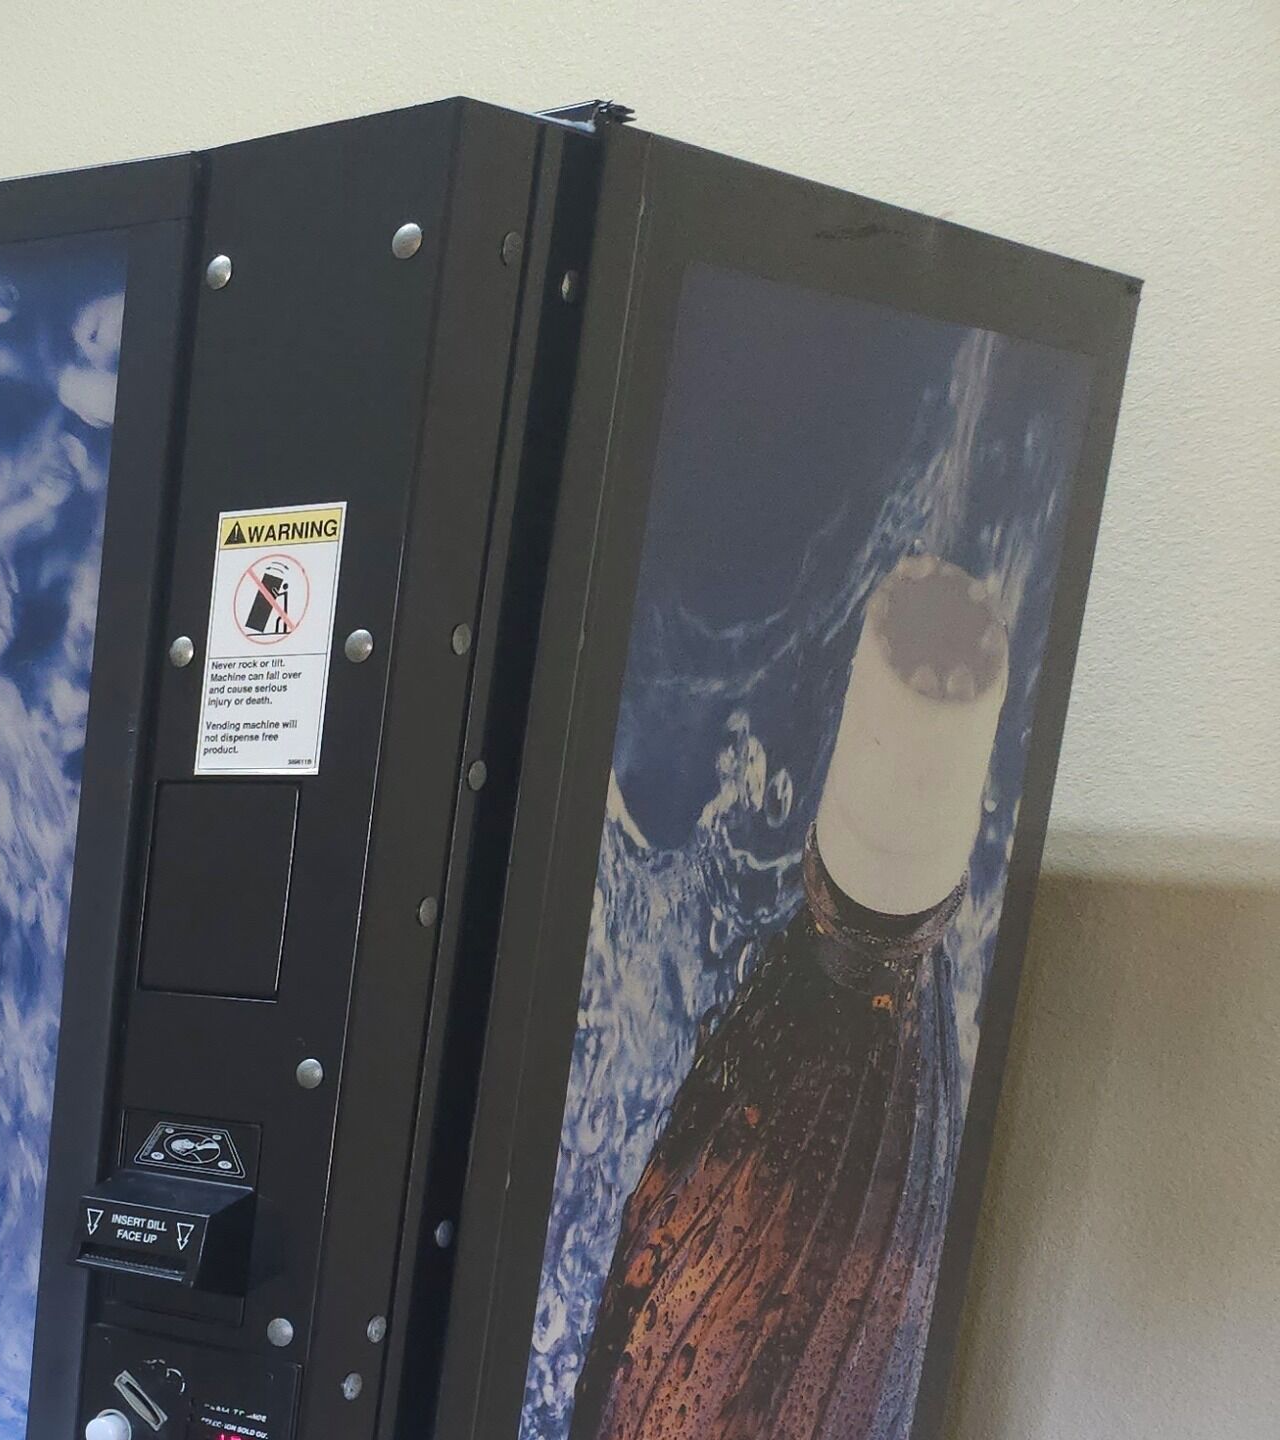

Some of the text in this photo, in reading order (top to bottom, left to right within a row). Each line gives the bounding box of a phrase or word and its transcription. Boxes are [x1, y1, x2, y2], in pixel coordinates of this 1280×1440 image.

[247, 519, 338, 543] WARNING
[211, 661, 236, 670] Never
[238, 660, 257, 668] rock
[272, 659, 285, 667] tilt.
[210, 673, 246, 682] Machine
[266, 672, 280, 680] fall
[209, 685, 225, 694] and
[254, 683, 288, 693] serious
[208, 699, 232, 708] injury
[246, 697, 272, 705] death.
[205, 720, 297, 731] Vending machine will
[204, 733, 279, 743] not dispense free
[203, 745, 238, 756] product.
[111, 1214, 167, 1231] INSERT BILL
[116, 1229, 158, 1244] FACE UP
